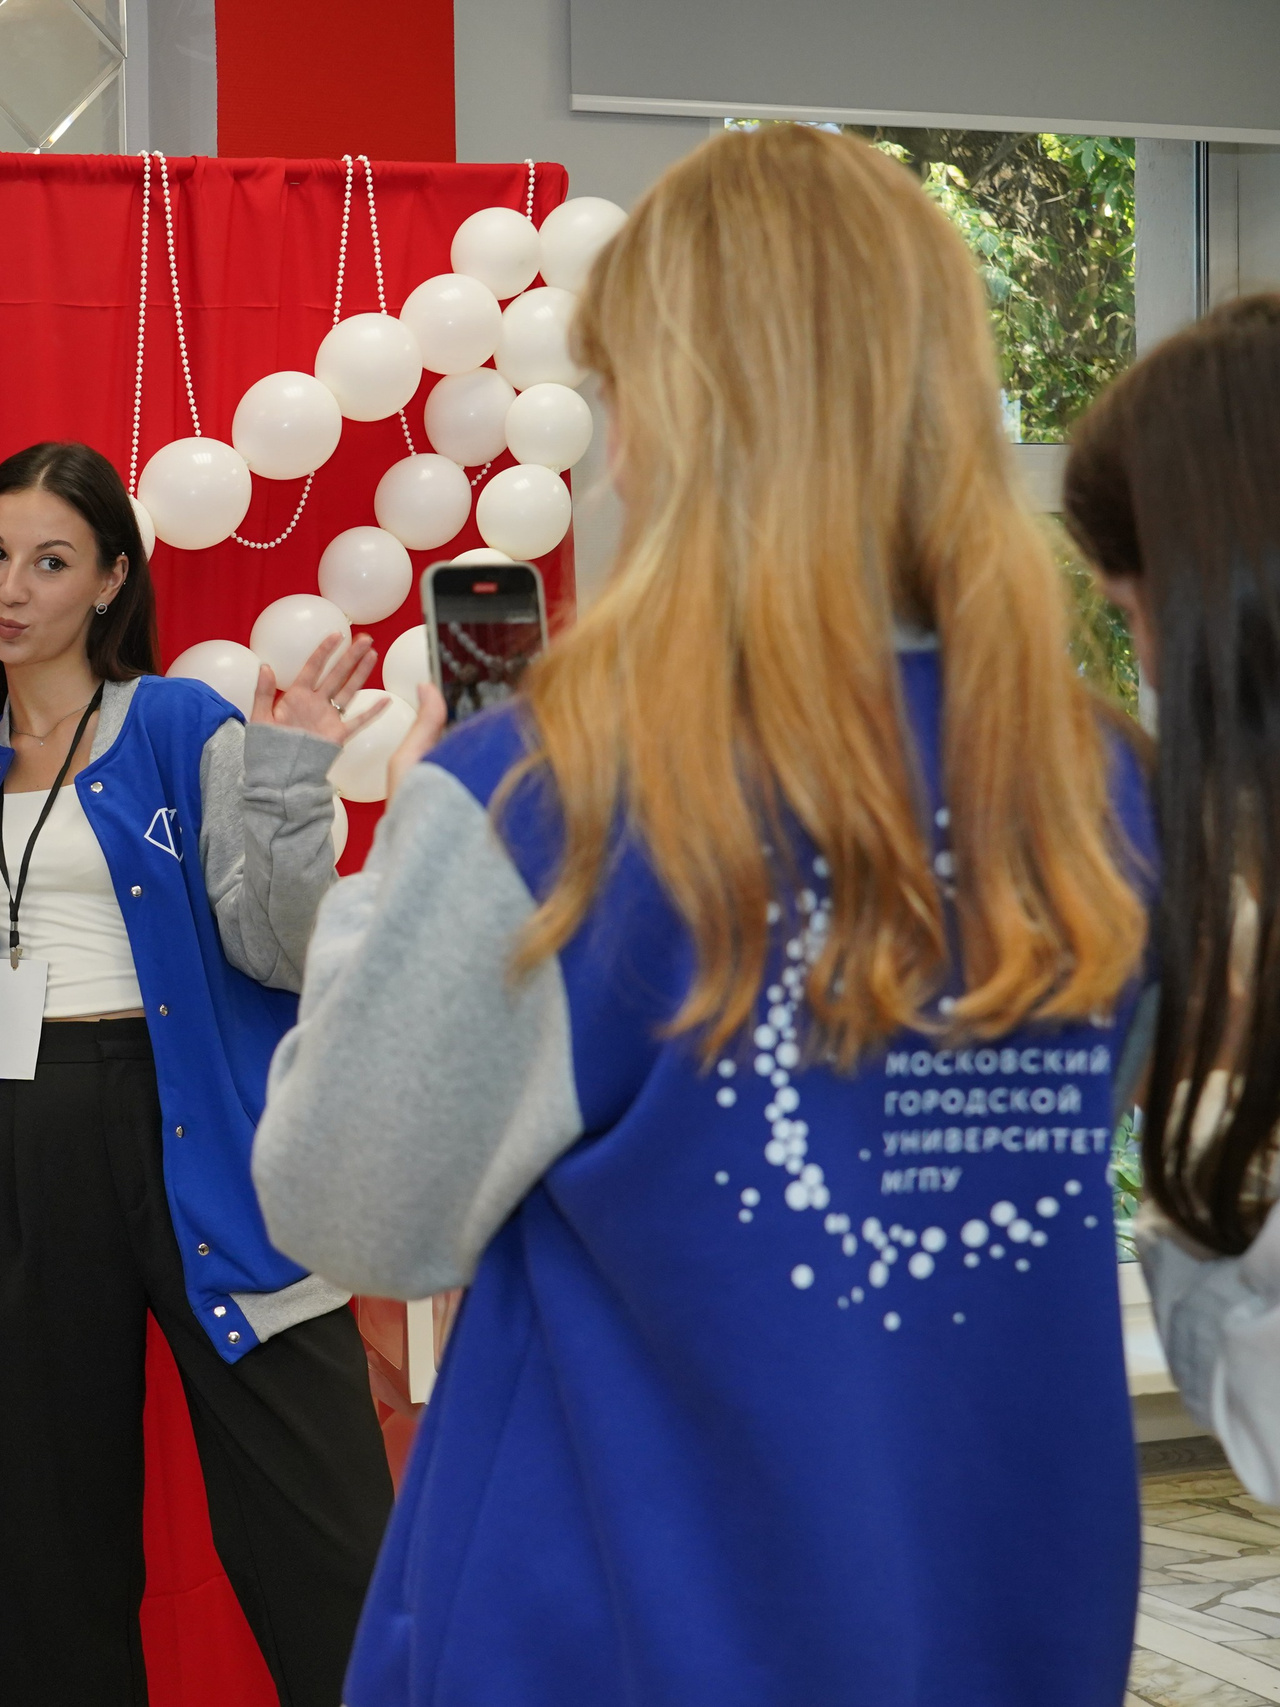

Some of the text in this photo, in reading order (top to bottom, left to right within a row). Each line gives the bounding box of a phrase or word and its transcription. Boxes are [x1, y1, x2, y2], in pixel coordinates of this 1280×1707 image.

[885, 1045, 1111, 1077] МОСКОВСКИЙ
[884, 1084, 1082, 1117] ГОРОДСКОЙ
[882, 1126, 1110, 1157] УНИВЕРСИТЕТ
[881, 1165, 963, 1195] МГПУ
